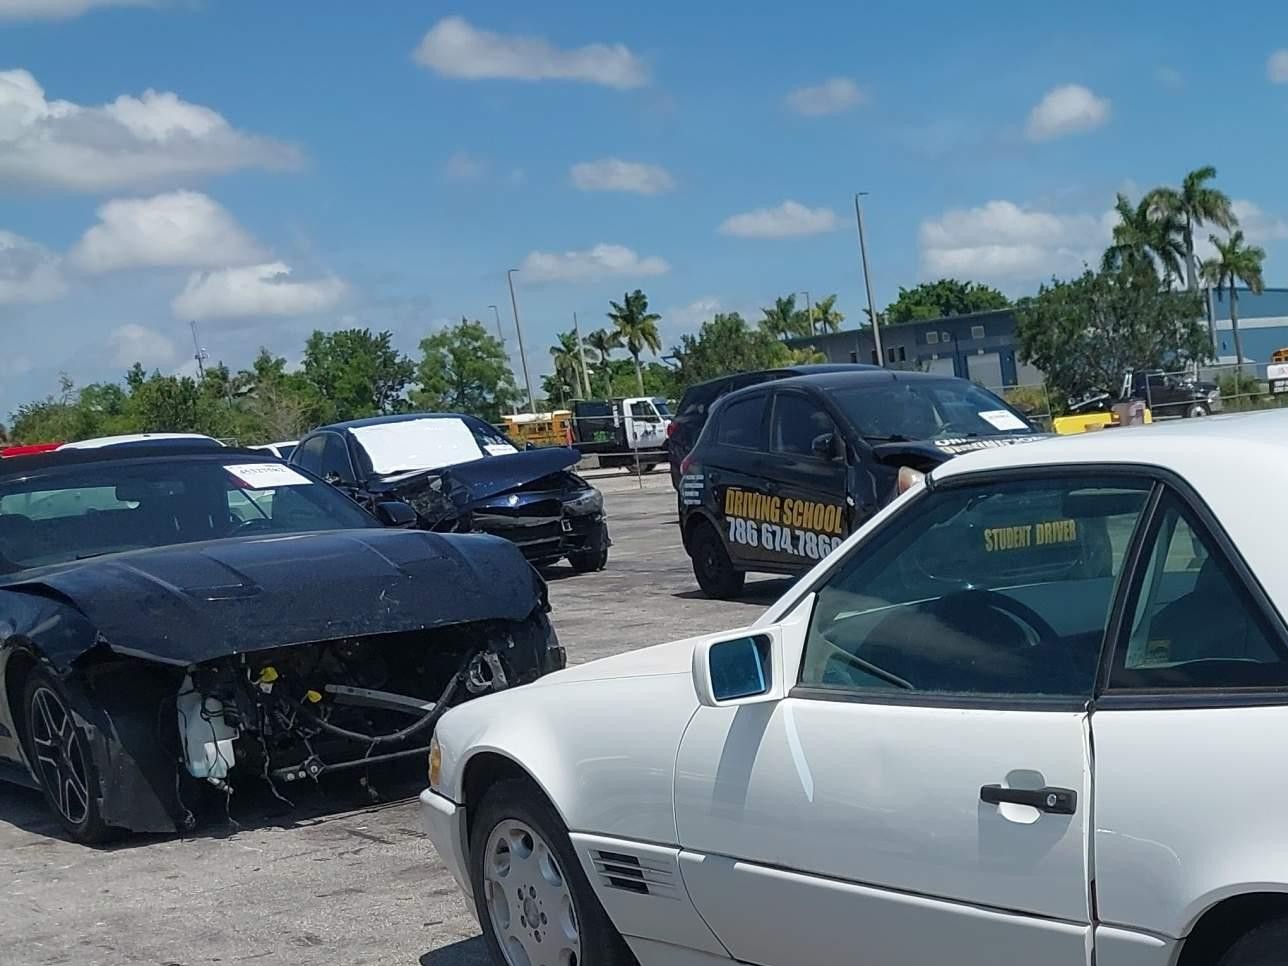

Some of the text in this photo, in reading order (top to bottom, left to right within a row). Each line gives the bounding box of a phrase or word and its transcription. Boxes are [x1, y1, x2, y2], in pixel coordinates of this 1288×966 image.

[725, 489, 780, 524] DRIVING
[783, 497, 843, 534] SCHOOL
[726, 517, 759, 547] 786
[984, 519, 1077, 552] STUDENT DRIVER
